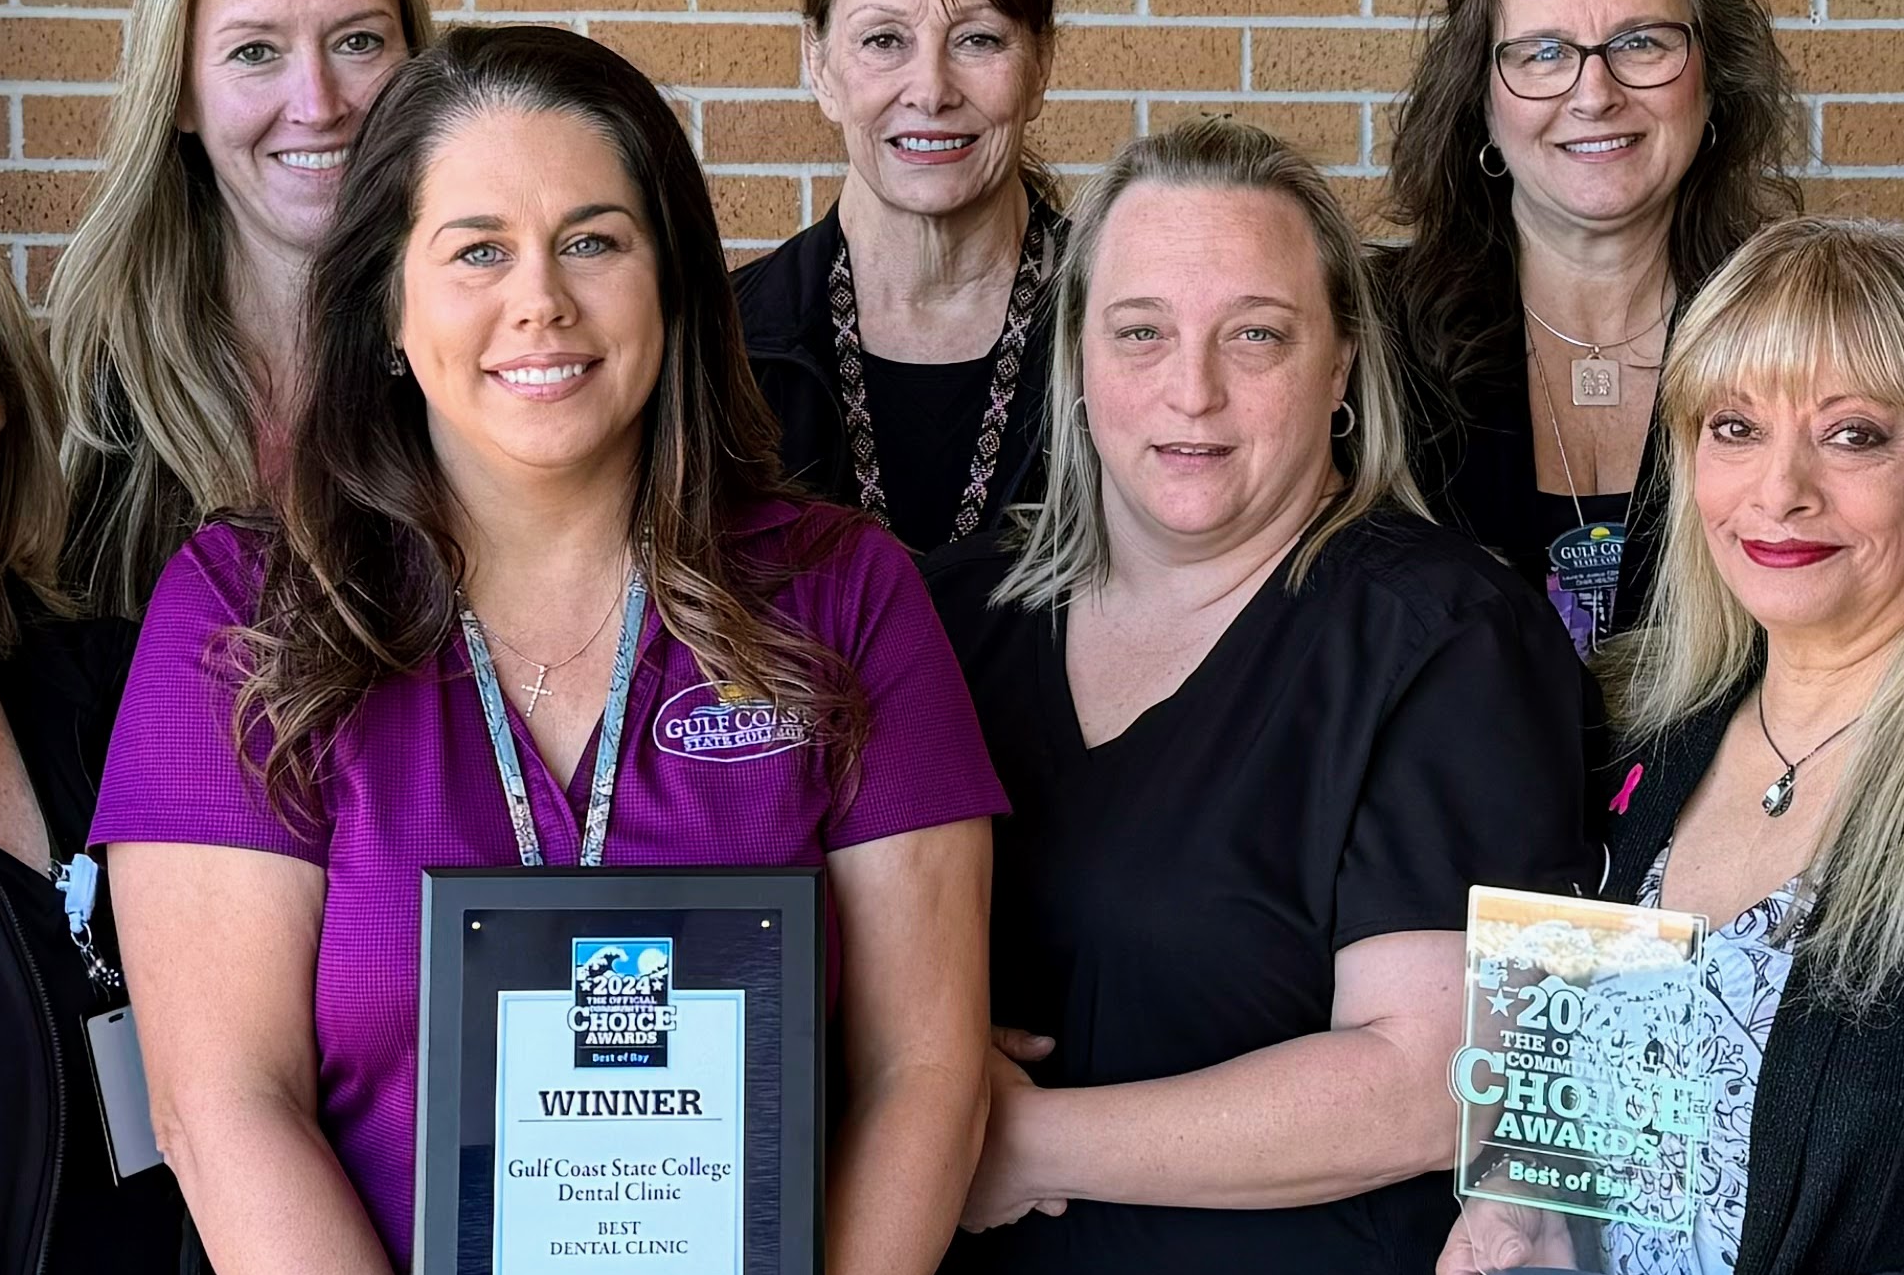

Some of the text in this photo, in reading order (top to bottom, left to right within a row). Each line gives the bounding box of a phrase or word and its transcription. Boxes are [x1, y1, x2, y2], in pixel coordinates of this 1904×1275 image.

[665, 715, 729, 738] GULF
[684, 737, 732, 750] STATE
[592, 975, 651, 995] 2024
[586, 996, 657, 1005] THE OFFICIAL
[567, 1005, 676, 1032] CHOICE
[585, 1032, 657, 1045] AWARDS
[1500, 1030, 1546, 1053] THE
[592, 1052, 649, 1063] Best of Bay
[538, 1089, 703, 1117] WINNER
[1494, 1112, 1660, 1163] AWARDS
[508, 1157, 731, 1182] Gulf Coast State College
[558, 1181, 681, 1201] Dental Clinic
[1509, 1161, 1641, 1203] Best of Bay
[598, 1221, 641, 1236] BEST
[550, 1240, 688, 1255] DENTAL CLINIC
